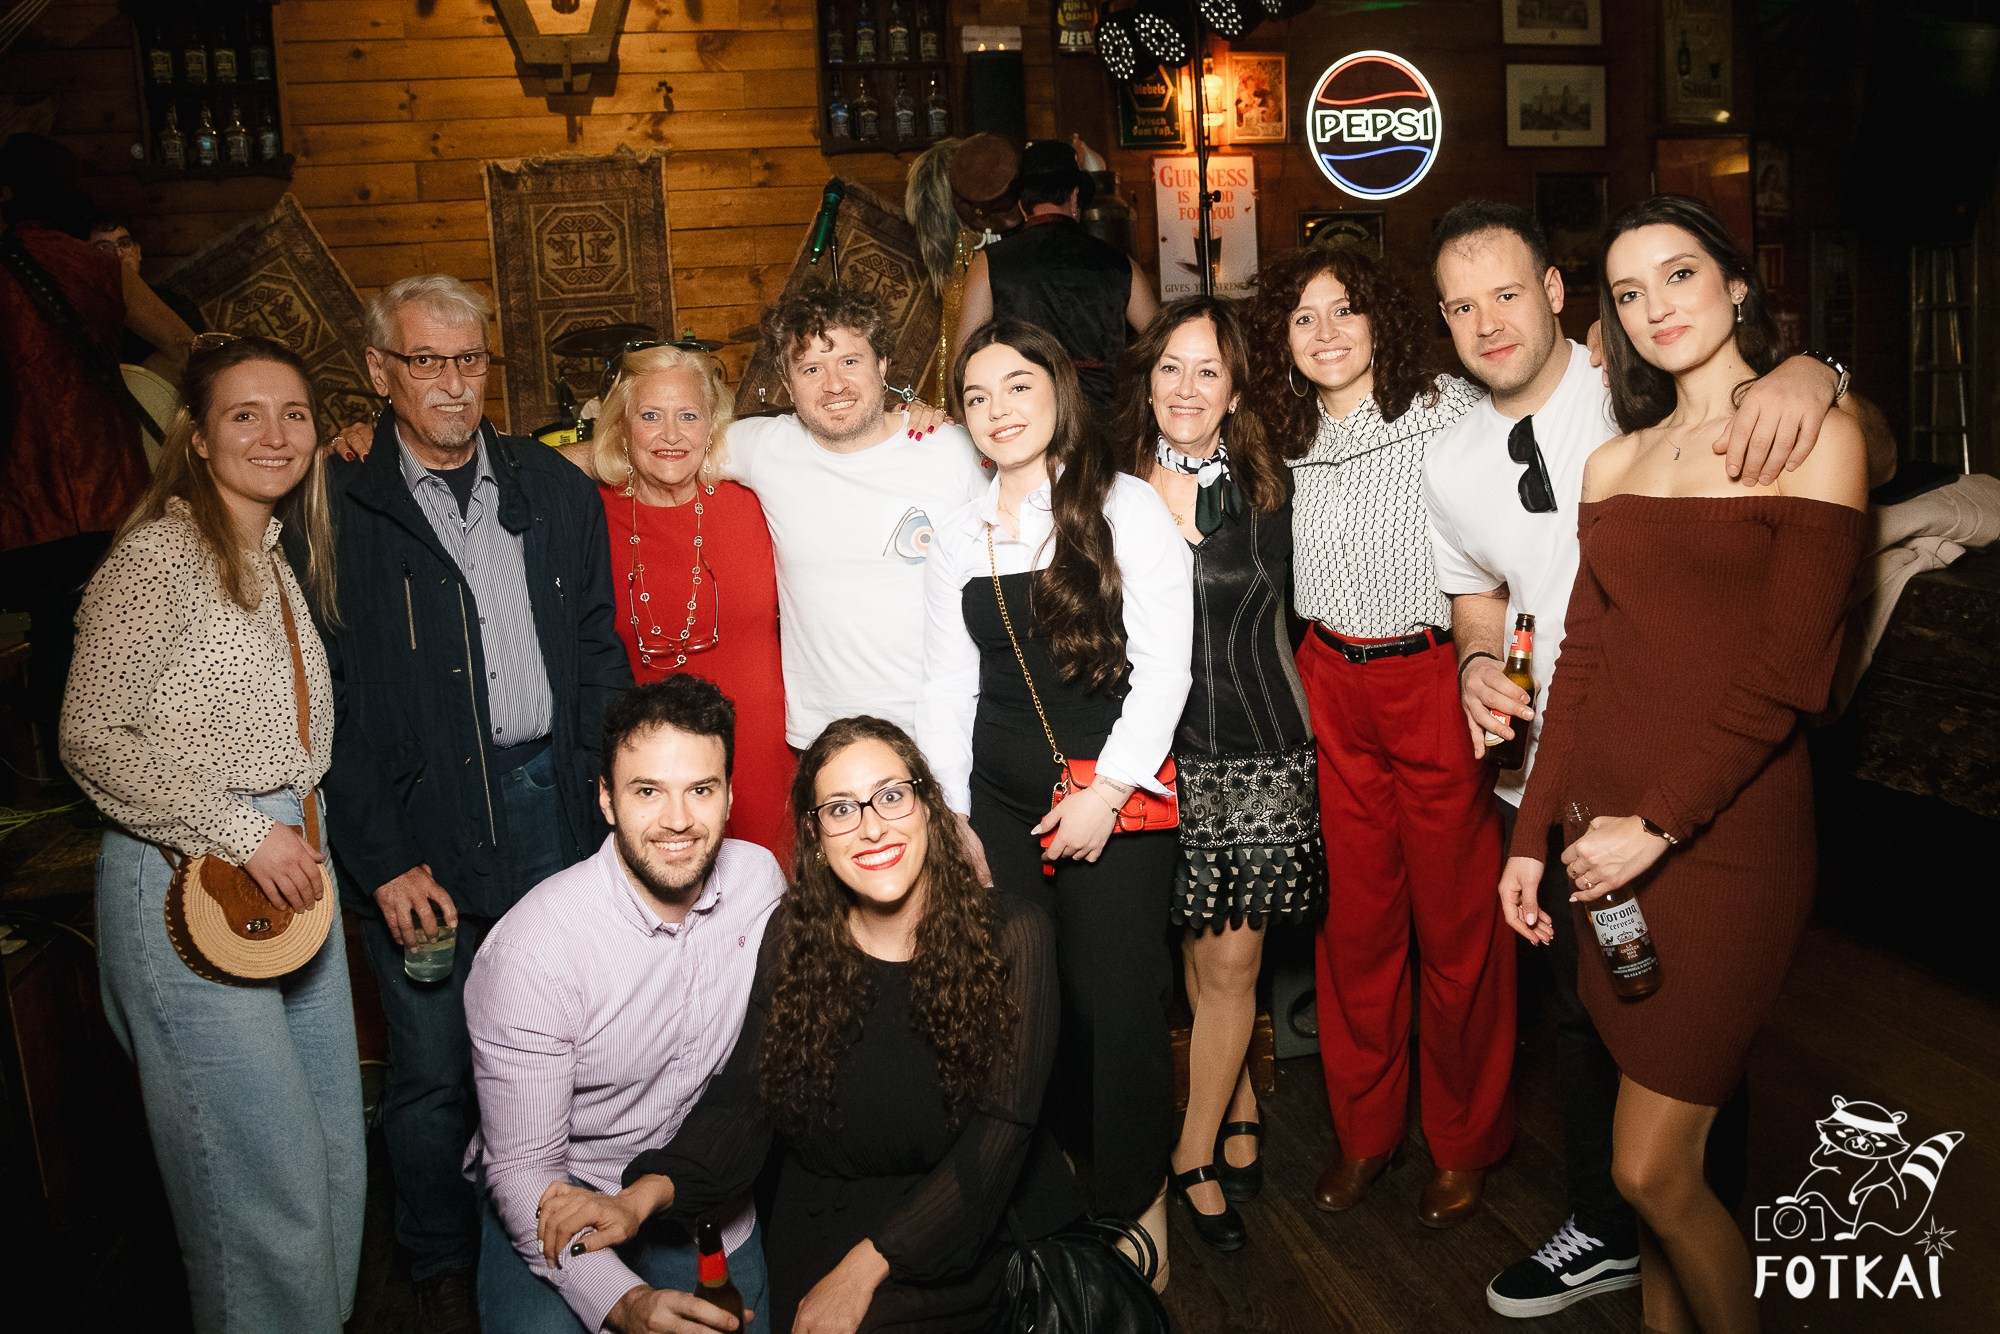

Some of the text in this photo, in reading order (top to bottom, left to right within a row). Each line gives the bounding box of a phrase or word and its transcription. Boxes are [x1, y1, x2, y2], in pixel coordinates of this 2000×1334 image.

[1060, 30, 1092, 45] BEER
[1315, 108, 1433, 142] PEPSI
[1178, 190, 1190, 203] IS
[1211, 206, 1234, 220] YOU
[1165, 284, 1190, 293] GIVES
[1595, 904, 1638, 926] Corona
[1610, 917, 1635, 930] cerveza
